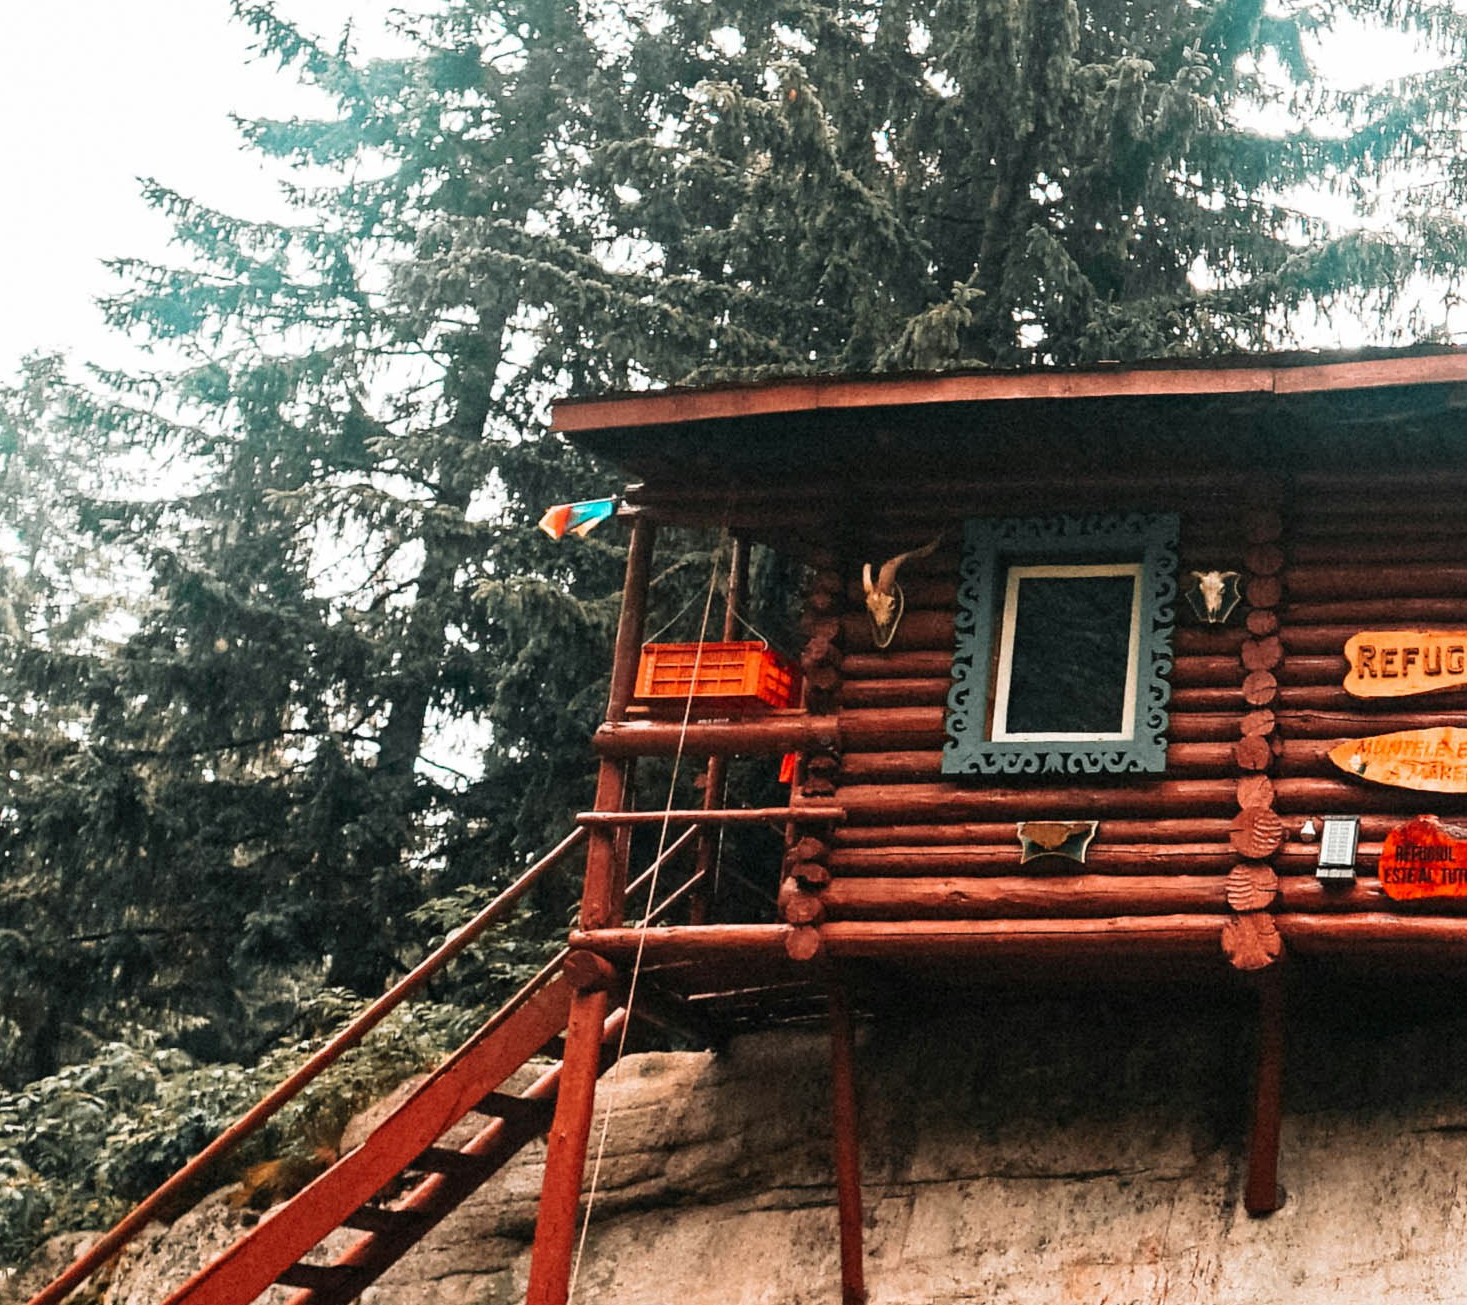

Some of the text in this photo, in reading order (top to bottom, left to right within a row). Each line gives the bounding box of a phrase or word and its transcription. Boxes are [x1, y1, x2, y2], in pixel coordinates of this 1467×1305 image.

[1356, 739, 1449, 759] MUNTELE
[1395, 844, 1457, 862] REFUGIUL
[1384, 866, 1415, 884] ESTE
[1418, 866, 1434, 883] AL
